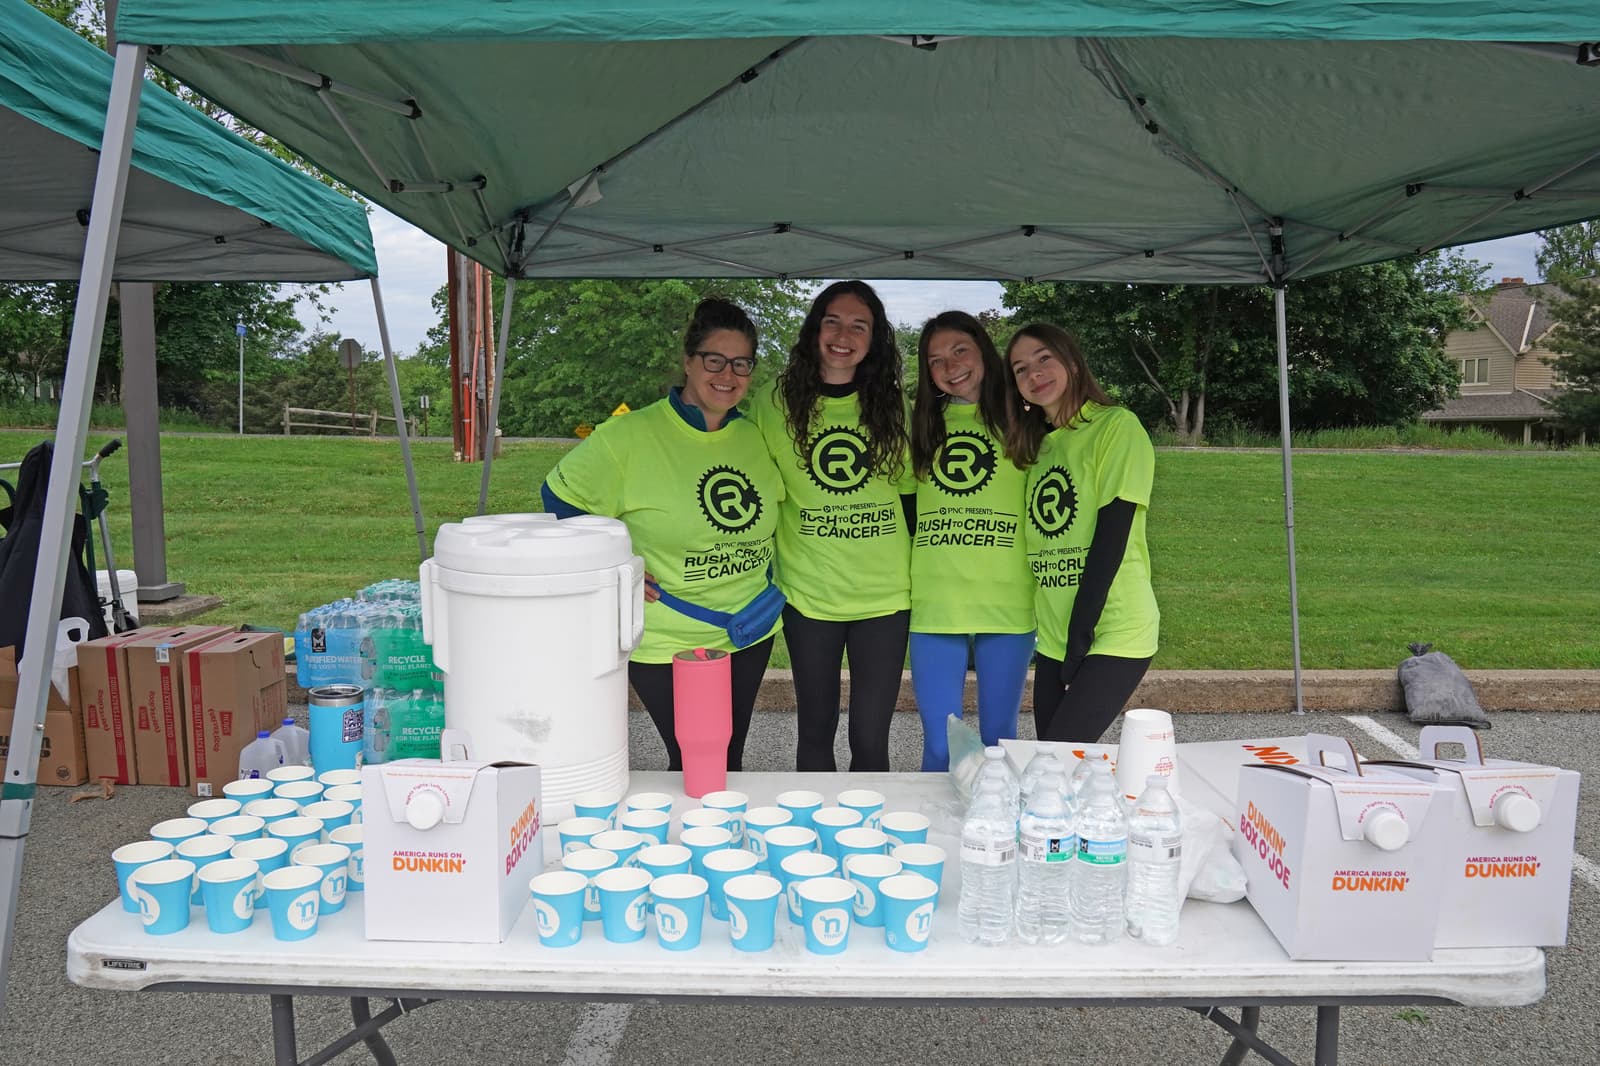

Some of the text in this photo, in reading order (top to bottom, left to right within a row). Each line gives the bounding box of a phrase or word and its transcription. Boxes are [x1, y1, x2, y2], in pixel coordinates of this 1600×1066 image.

[832, 502, 877, 512] PNC PRESENTS
[965, 507, 993, 515] PRESENTS
[800, 510, 837, 526] RUSH
[850, 507, 895, 524] CRUSH
[817, 525, 880, 539] CANCER
[918, 518, 952, 533] RUSH
[964, 518, 1018, 534] CRUSH
[721, 541, 736, 549] PNC
[930, 533, 995, 547] CANCER
[1057, 547, 1082, 555] PRESENTS
[684, 552, 731, 567] RUSH
[1031, 557, 1087, 573] SH TO CRU
[707, 557, 765, 579] CANCER
[388, 655, 426, 664] RECYCLE
[113, 714, 122, 738] QUALITY
[165, 714, 174, 738] QUALITY
[402, 726, 441, 735] RECYCLE
[1248, 800, 1286, 857] DUNKIN'
[393, 850, 427, 858] AMERICA
[506, 839, 521, 875] BOX
[1240, 813, 1258, 850] BOX
[1268, 852, 1291, 890] JOE
[393, 857, 466, 873] DUNKIN'
[1465, 863, 1541, 878] DUNKIN'
[1332, 876, 1409, 892] DUNKIN'
